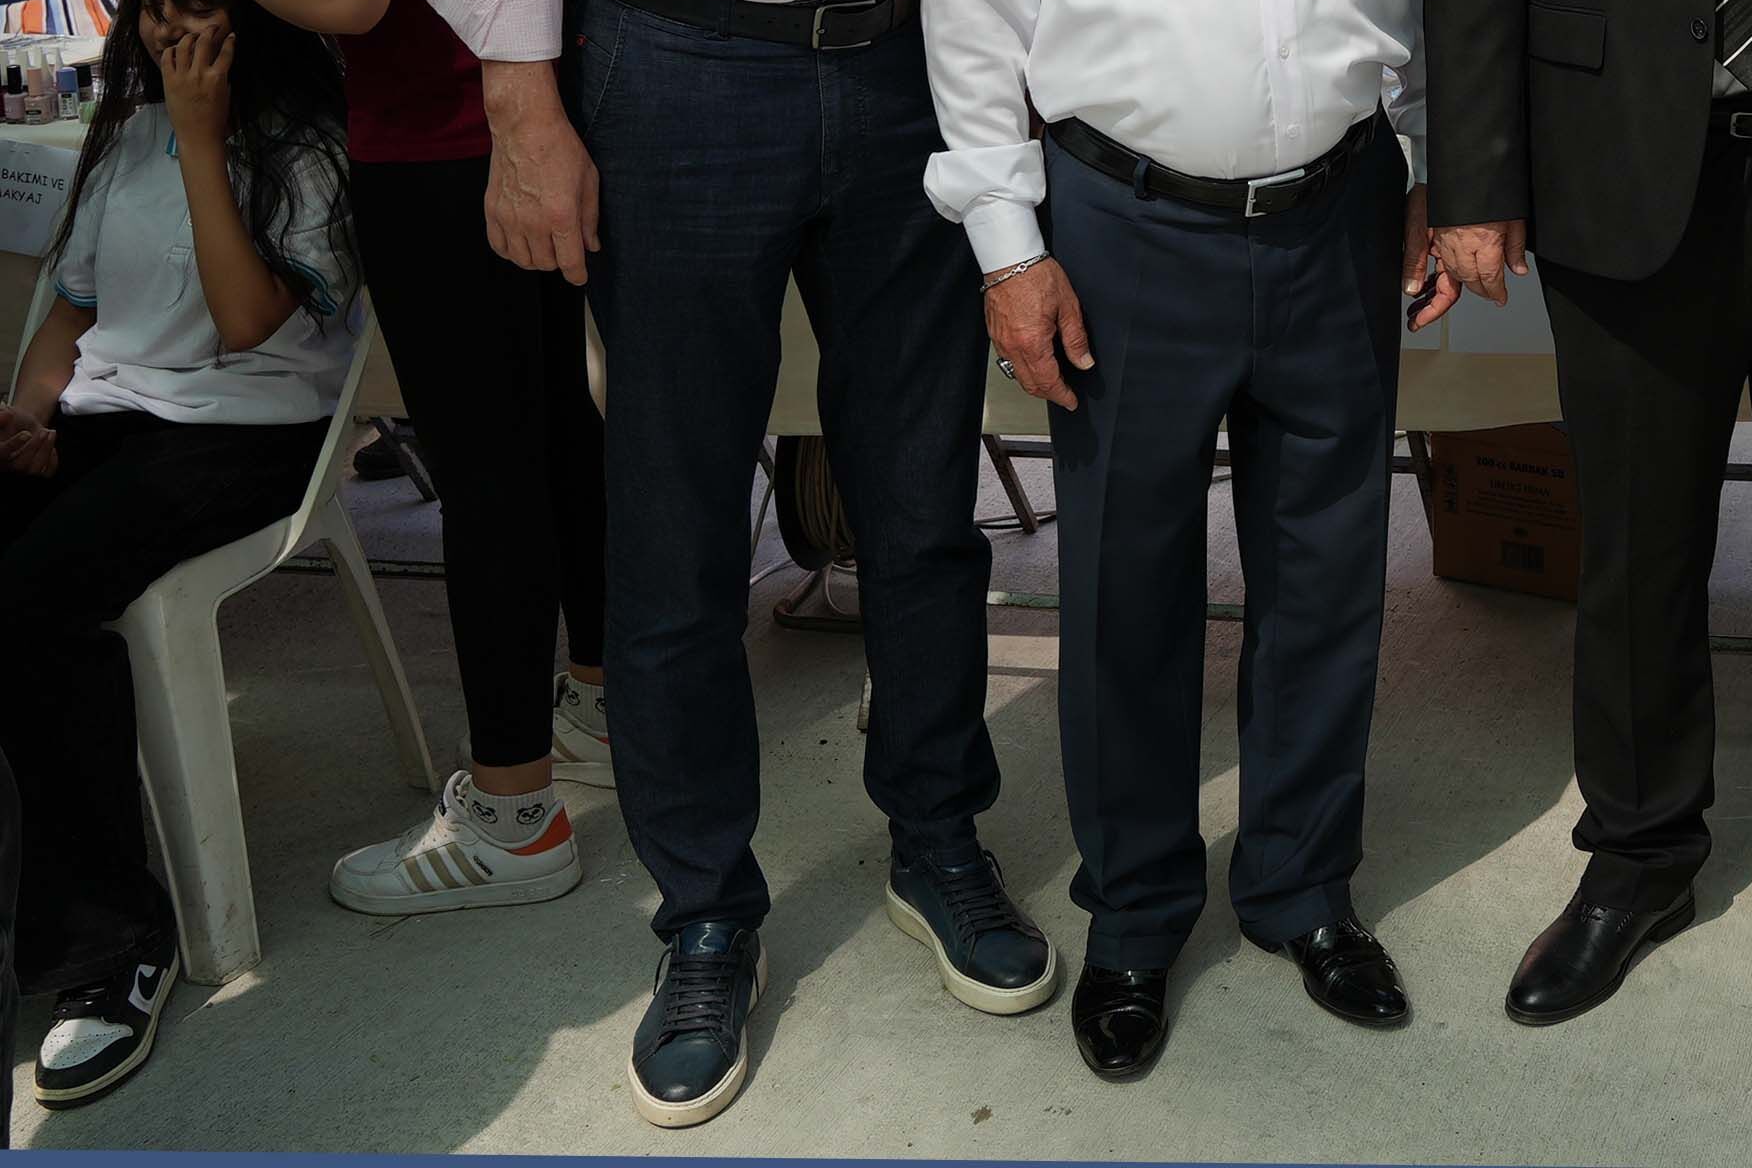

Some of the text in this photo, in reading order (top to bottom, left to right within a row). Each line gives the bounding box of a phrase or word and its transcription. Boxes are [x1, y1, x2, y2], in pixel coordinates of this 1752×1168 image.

[1, 167, 64, 190] BAKIMI VE
[0, 189, 43, 205] AKYAJ
